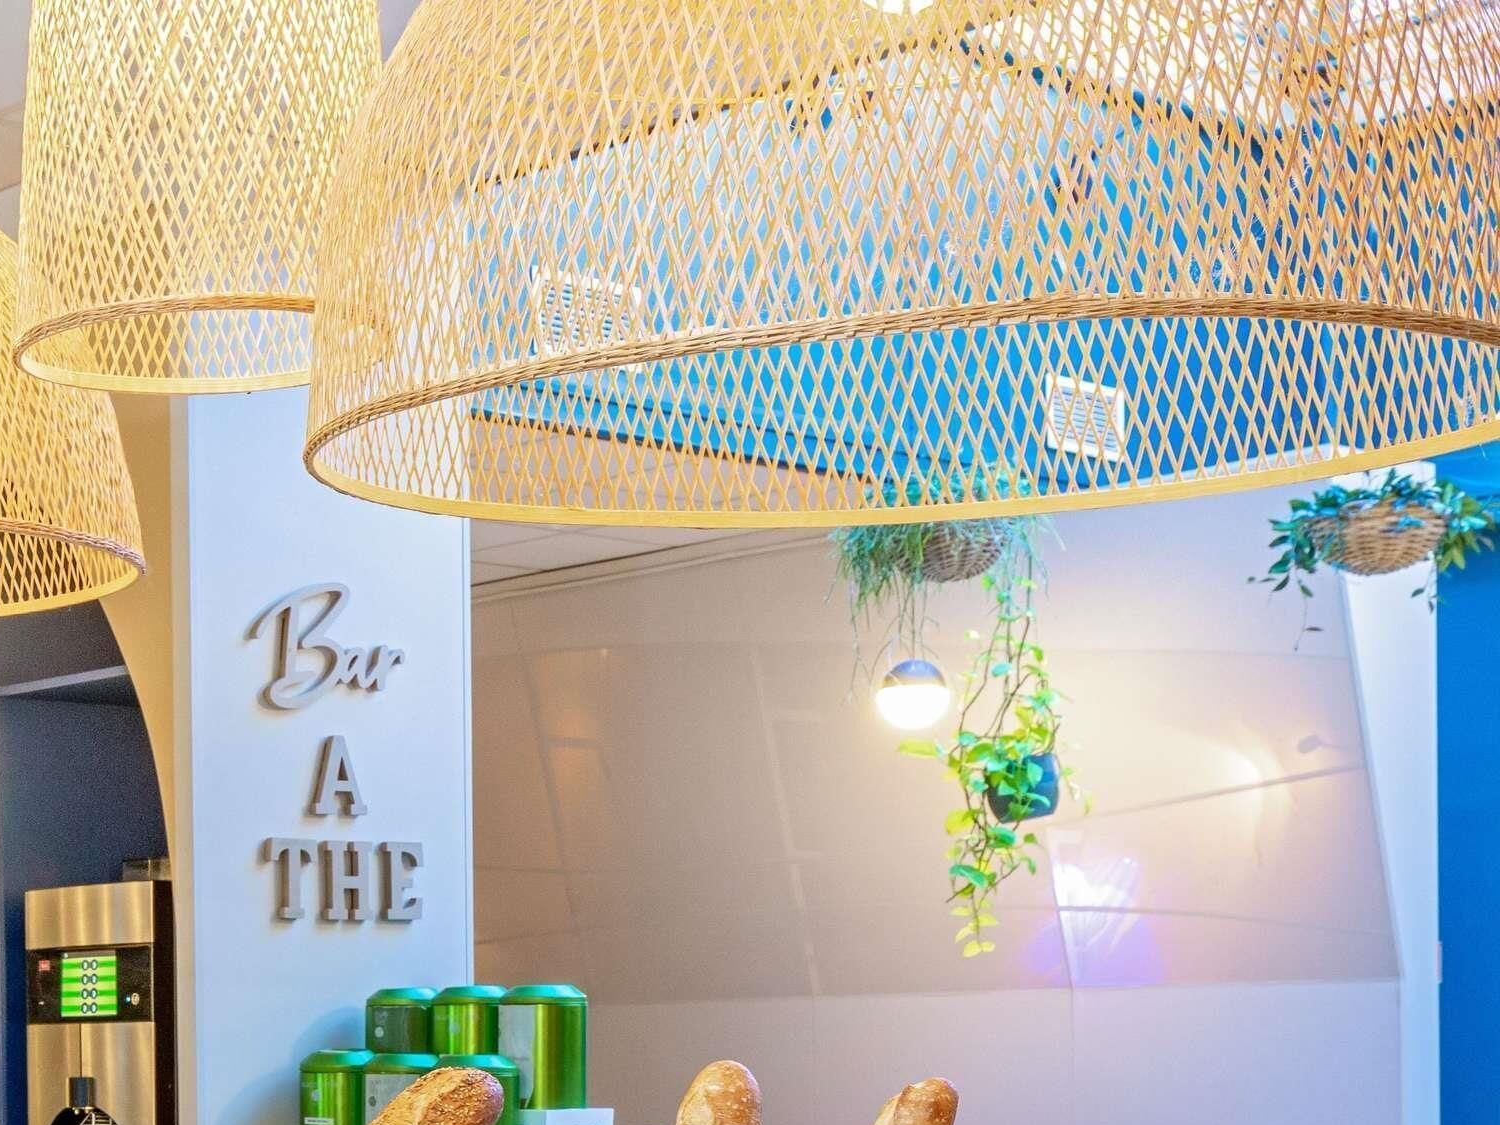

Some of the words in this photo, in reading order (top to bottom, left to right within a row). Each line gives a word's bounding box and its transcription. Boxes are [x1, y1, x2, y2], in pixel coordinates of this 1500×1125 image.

[243, 582, 405, 710] Bar
[304, 735, 367, 817] A
[263, 838, 424, 921] THE
